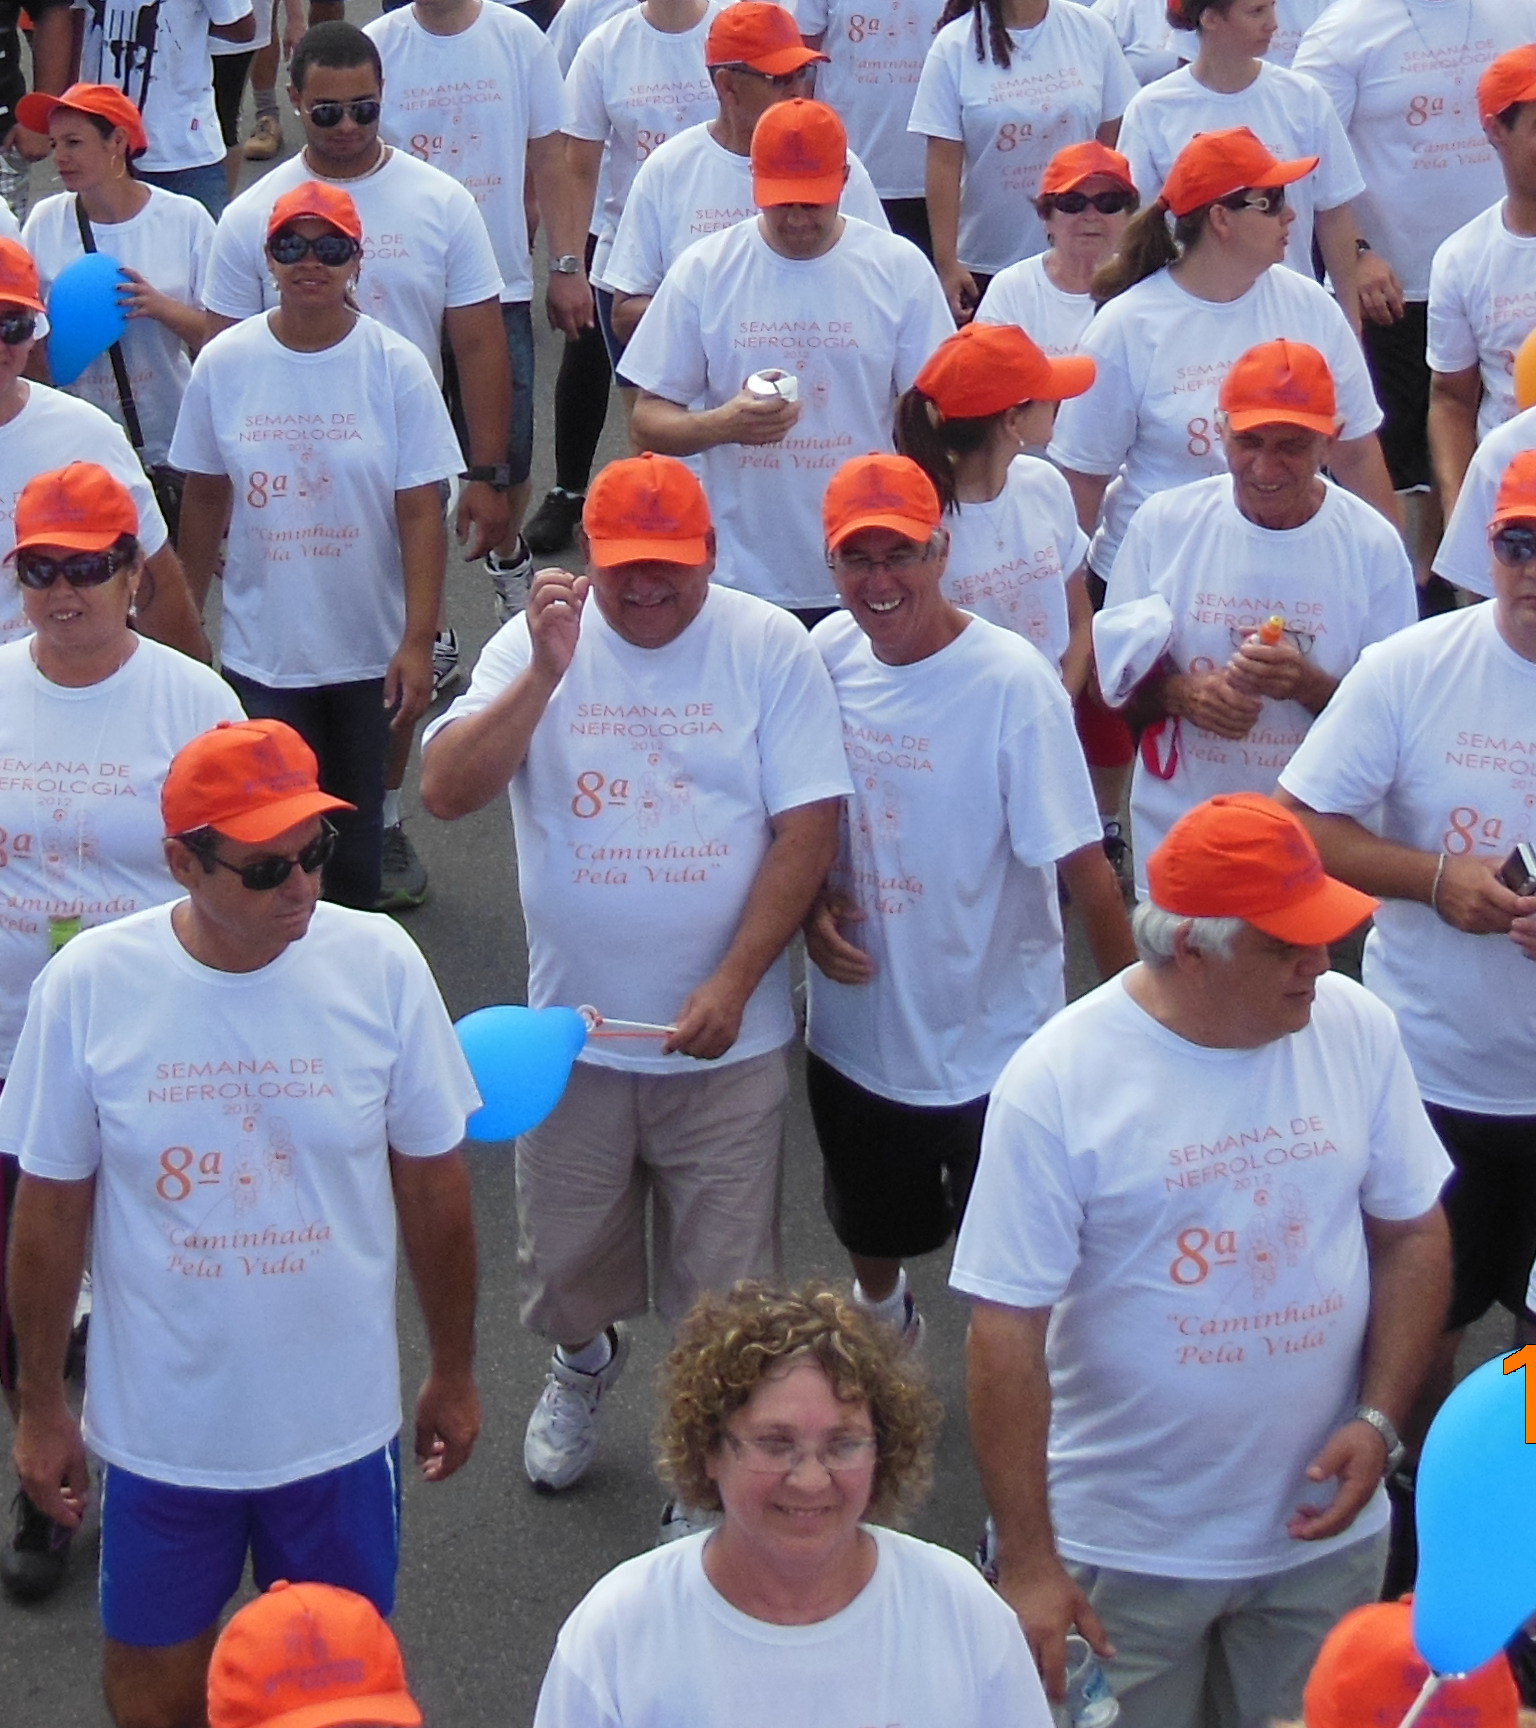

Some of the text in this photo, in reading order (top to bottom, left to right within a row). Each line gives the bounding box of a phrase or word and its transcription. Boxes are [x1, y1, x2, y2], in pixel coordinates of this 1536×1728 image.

[1407, 93, 1445, 127] 8ª
[410, 133, 444, 163] 8ª
[996, 121, 1032, 153] 8ª
[739, 321, 853, 335] SEMANA DE
[732, 336, 859, 351] NEFROLOGIA
[244, 412, 357, 428] SEMANA DE
[238, 427, 363, 443] NEFROLOGIA
[246, 471, 288, 509] 8ª
[1194, 592, 1323, 616] SEMANA DE
[576, 701, 715, 720] SEMANA DE
[569, 720, 725, 738] NEFROLOGIA
[631, 739, 664, 753] 2012
[99, 762, 130, 778] DE
[36, 795, 73, 807] 2012
[570, 770, 630, 820] 8ª
[1445, 807, 1503, 857] 8ª
[570, 863, 629, 886] Pela
[156, 1057, 325, 1080] SEMANA DE
[148, 1081, 335, 1104] NEFROLOGIA
[223, 1103, 263, 1116] 2012
[1168, 1115, 1324, 1167] SEMANA DE
[156, 1145, 223, 1202] 8ª
[1165, 1138, 1338, 1192] NEFROLOGIA
[1233, 1173, 1273, 1191] 2012
[165, 1252, 223, 1279] Pela
[1169, 1226, 1238, 1286] 8ª
[1177, 1342, 1245, 1365] Pela
